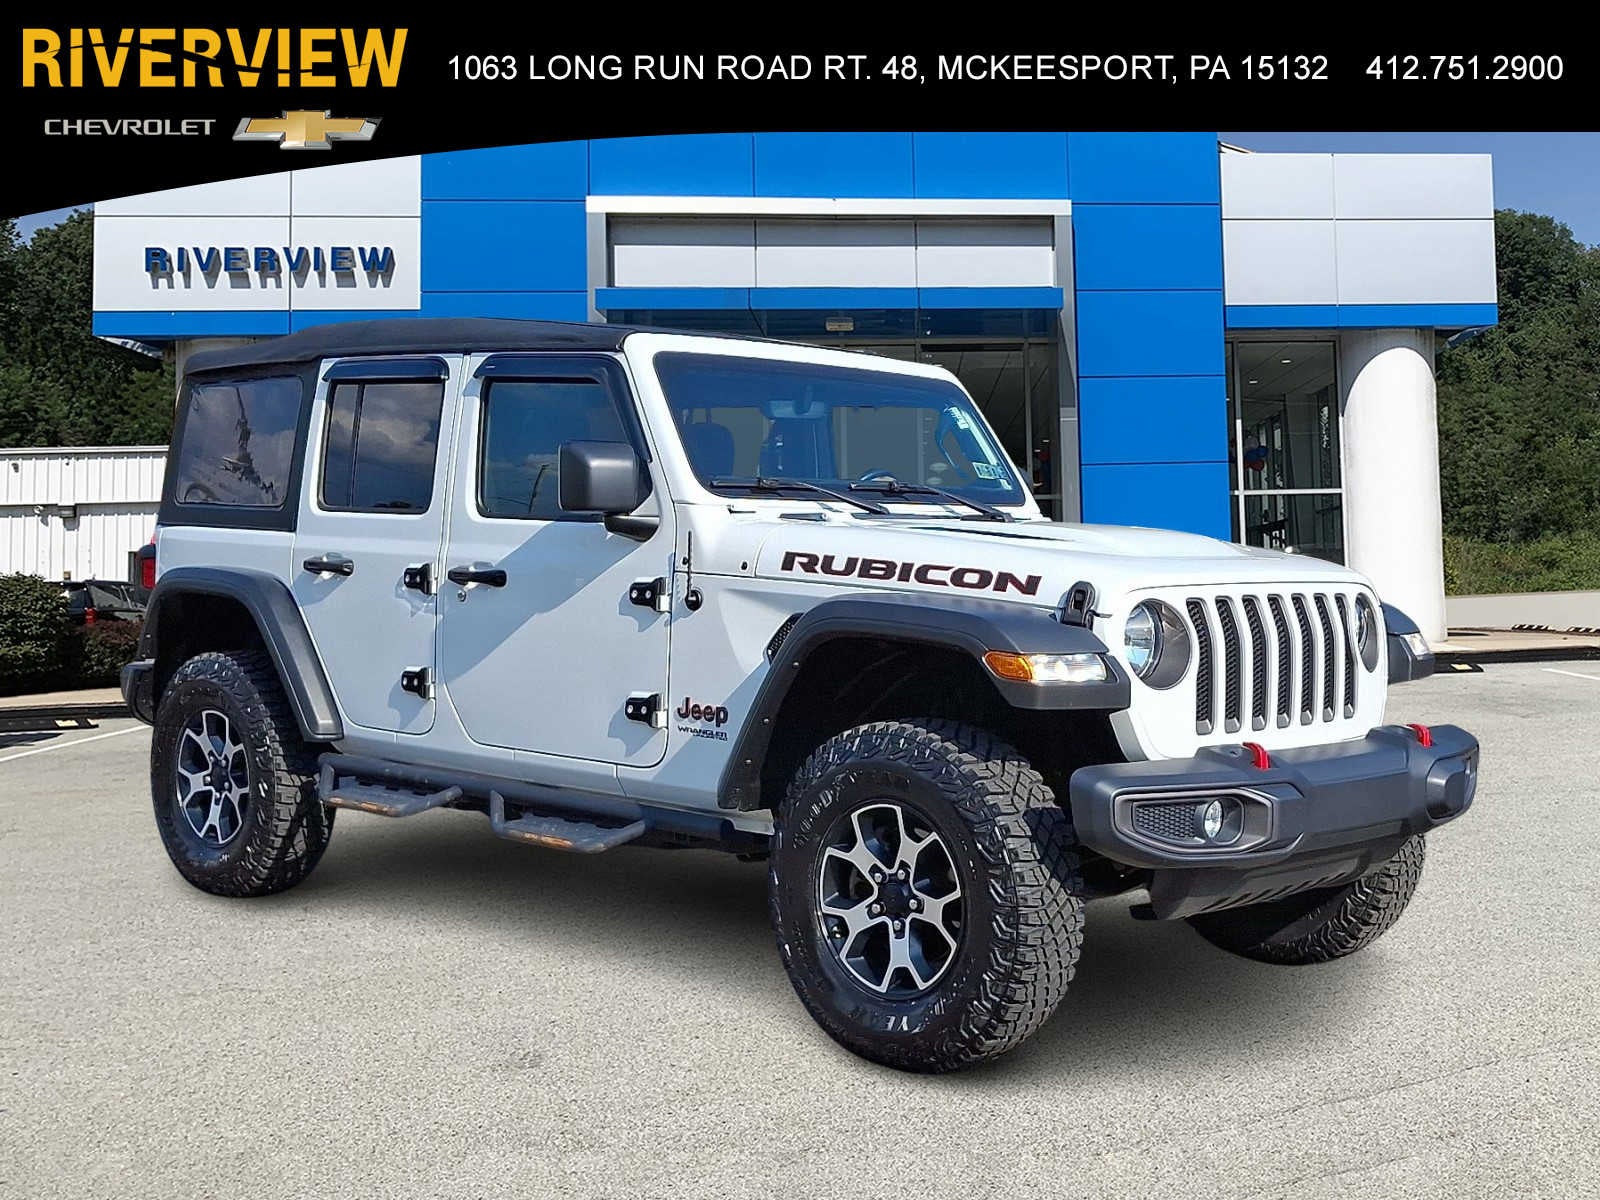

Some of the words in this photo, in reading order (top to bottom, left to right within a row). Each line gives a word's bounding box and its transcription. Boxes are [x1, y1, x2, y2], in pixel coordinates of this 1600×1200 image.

[145, 247, 394, 275] RIVERVIEW
[780, 550, 1042, 596] RUBICON
[677, 696, 729, 728] Jeep
[677, 725, 728, 738] WRANGLER
